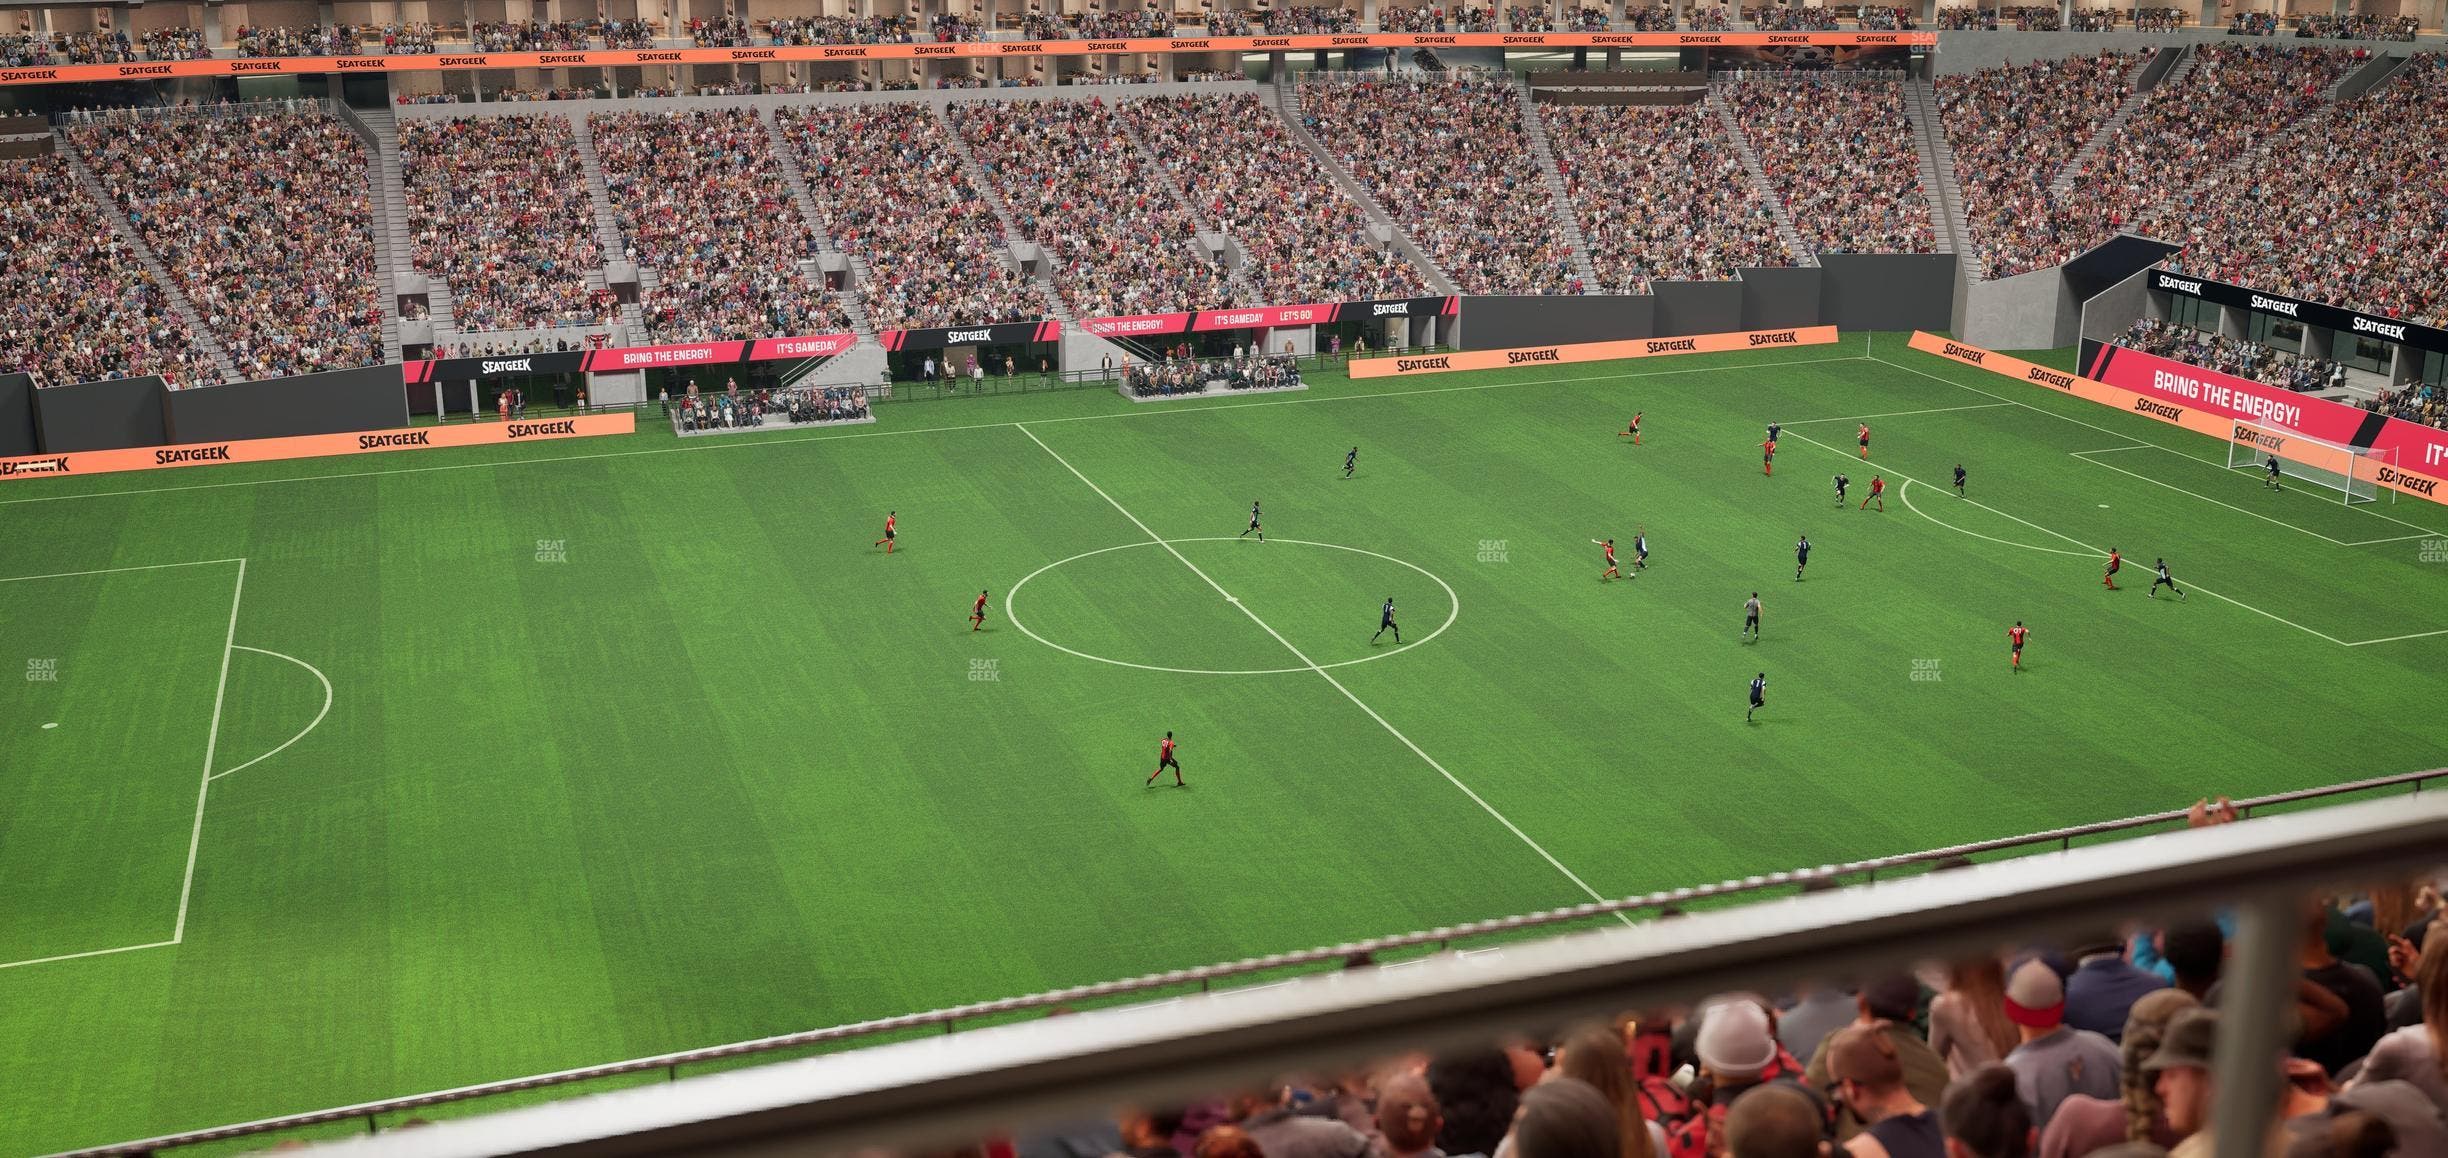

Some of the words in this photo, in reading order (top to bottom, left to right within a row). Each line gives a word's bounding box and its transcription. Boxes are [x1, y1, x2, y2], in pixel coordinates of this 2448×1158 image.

[1171, 40, 1210, 49] SEATGEEK
[1252, 39, 1290, 48] SEATGEEK
[1332, 37, 1369, 45] SEATGEEK
[1414, 35, 1456, 44] SEATGEEK
[1503, 36, 1544, 44] SEATGEEK
[1592, 36, 1633, 44] SEATGEEK
[1680, 35, 1721, 44] SEATGEEK
[1768, 35, 1809, 44] SEATGEEK
[1856, 34, 1897, 43] SEATGEEK
[824, 48, 867, 57] SEATGEEK
[914, 46, 956, 55] SEATGEEK
[1002, 44, 1042, 53] SEATGEEK
[1087, 42, 1127, 51] SEATGEEK
[540, 54, 585, 64] SEATGEEK
[637, 52, 682, 61] SEATGEEK
[732, 50, 776, 59] SEATGEEK
[231, 61, 281, 71] SEATGEEK
[337, 59, 385, 69] SEATGEEK
[440, 56, 486, 66] SEATGEEK
[1, 70, 57, 81] SEATGEEK
[119, 65, 172, 76] SEATGEEK
[2159, 274, 2202, 296] SEATGEEK
[1373, 301, 1409, 316] SEATGEEK
[2251, 293, 2299, 317] SEATGEEK
[1215, 315, 1229, 325] IT'S
[1229, 313, 1264, 324] GAMEDAY
[1280, 310, 1299, 321] LET'S
[1300, 309, 1313, 320] GO!
[1117, 321, 1131, 332] THE
[1132, 319, 1163, 331] ENERGY!
[2353, 315, 2406, 340] SEATGEEK
[949, 328, 992, 344] SEATGEEK
[1750, 330, 1797, 346] SEATGEEK
[777, 343, 794, 354] IT'S
[795, 340, 838, 353] GAMEDAY
[1647, 338, 1697, 354] SEATGEEK
[623, 351, 653, 364] BRING
[654, 350, 672, 362] THE
[673, 348, 713, 361] ENERGY!
[1508, 348, 1560, 365] SEATGEEK
[1943, 342, 1986, 365] SEATGEEK
[482, 358, 532, 375] SEATGEEK
[1397, 356, 1450, 372] SEATGEEK
[2027, 366, 2075, 391] SEATGEEK
[2154, 369, 2199, 399] BRING
[2203, 382, 2231, 408] THE
[2233, 391, 2301, 427] ENERGY!
[2134, 398, 2183, 422] SEATGEEK
[508, 419, 576, 439] SEATGEEK
[359, 430, 430, 450] SEATGEEK
[2234, 426, 2286, 453] SEATGEEK
[156, 444, 230, 465] SEATGEEK
[2376, 467, 2438, 497] SEATGEEK
